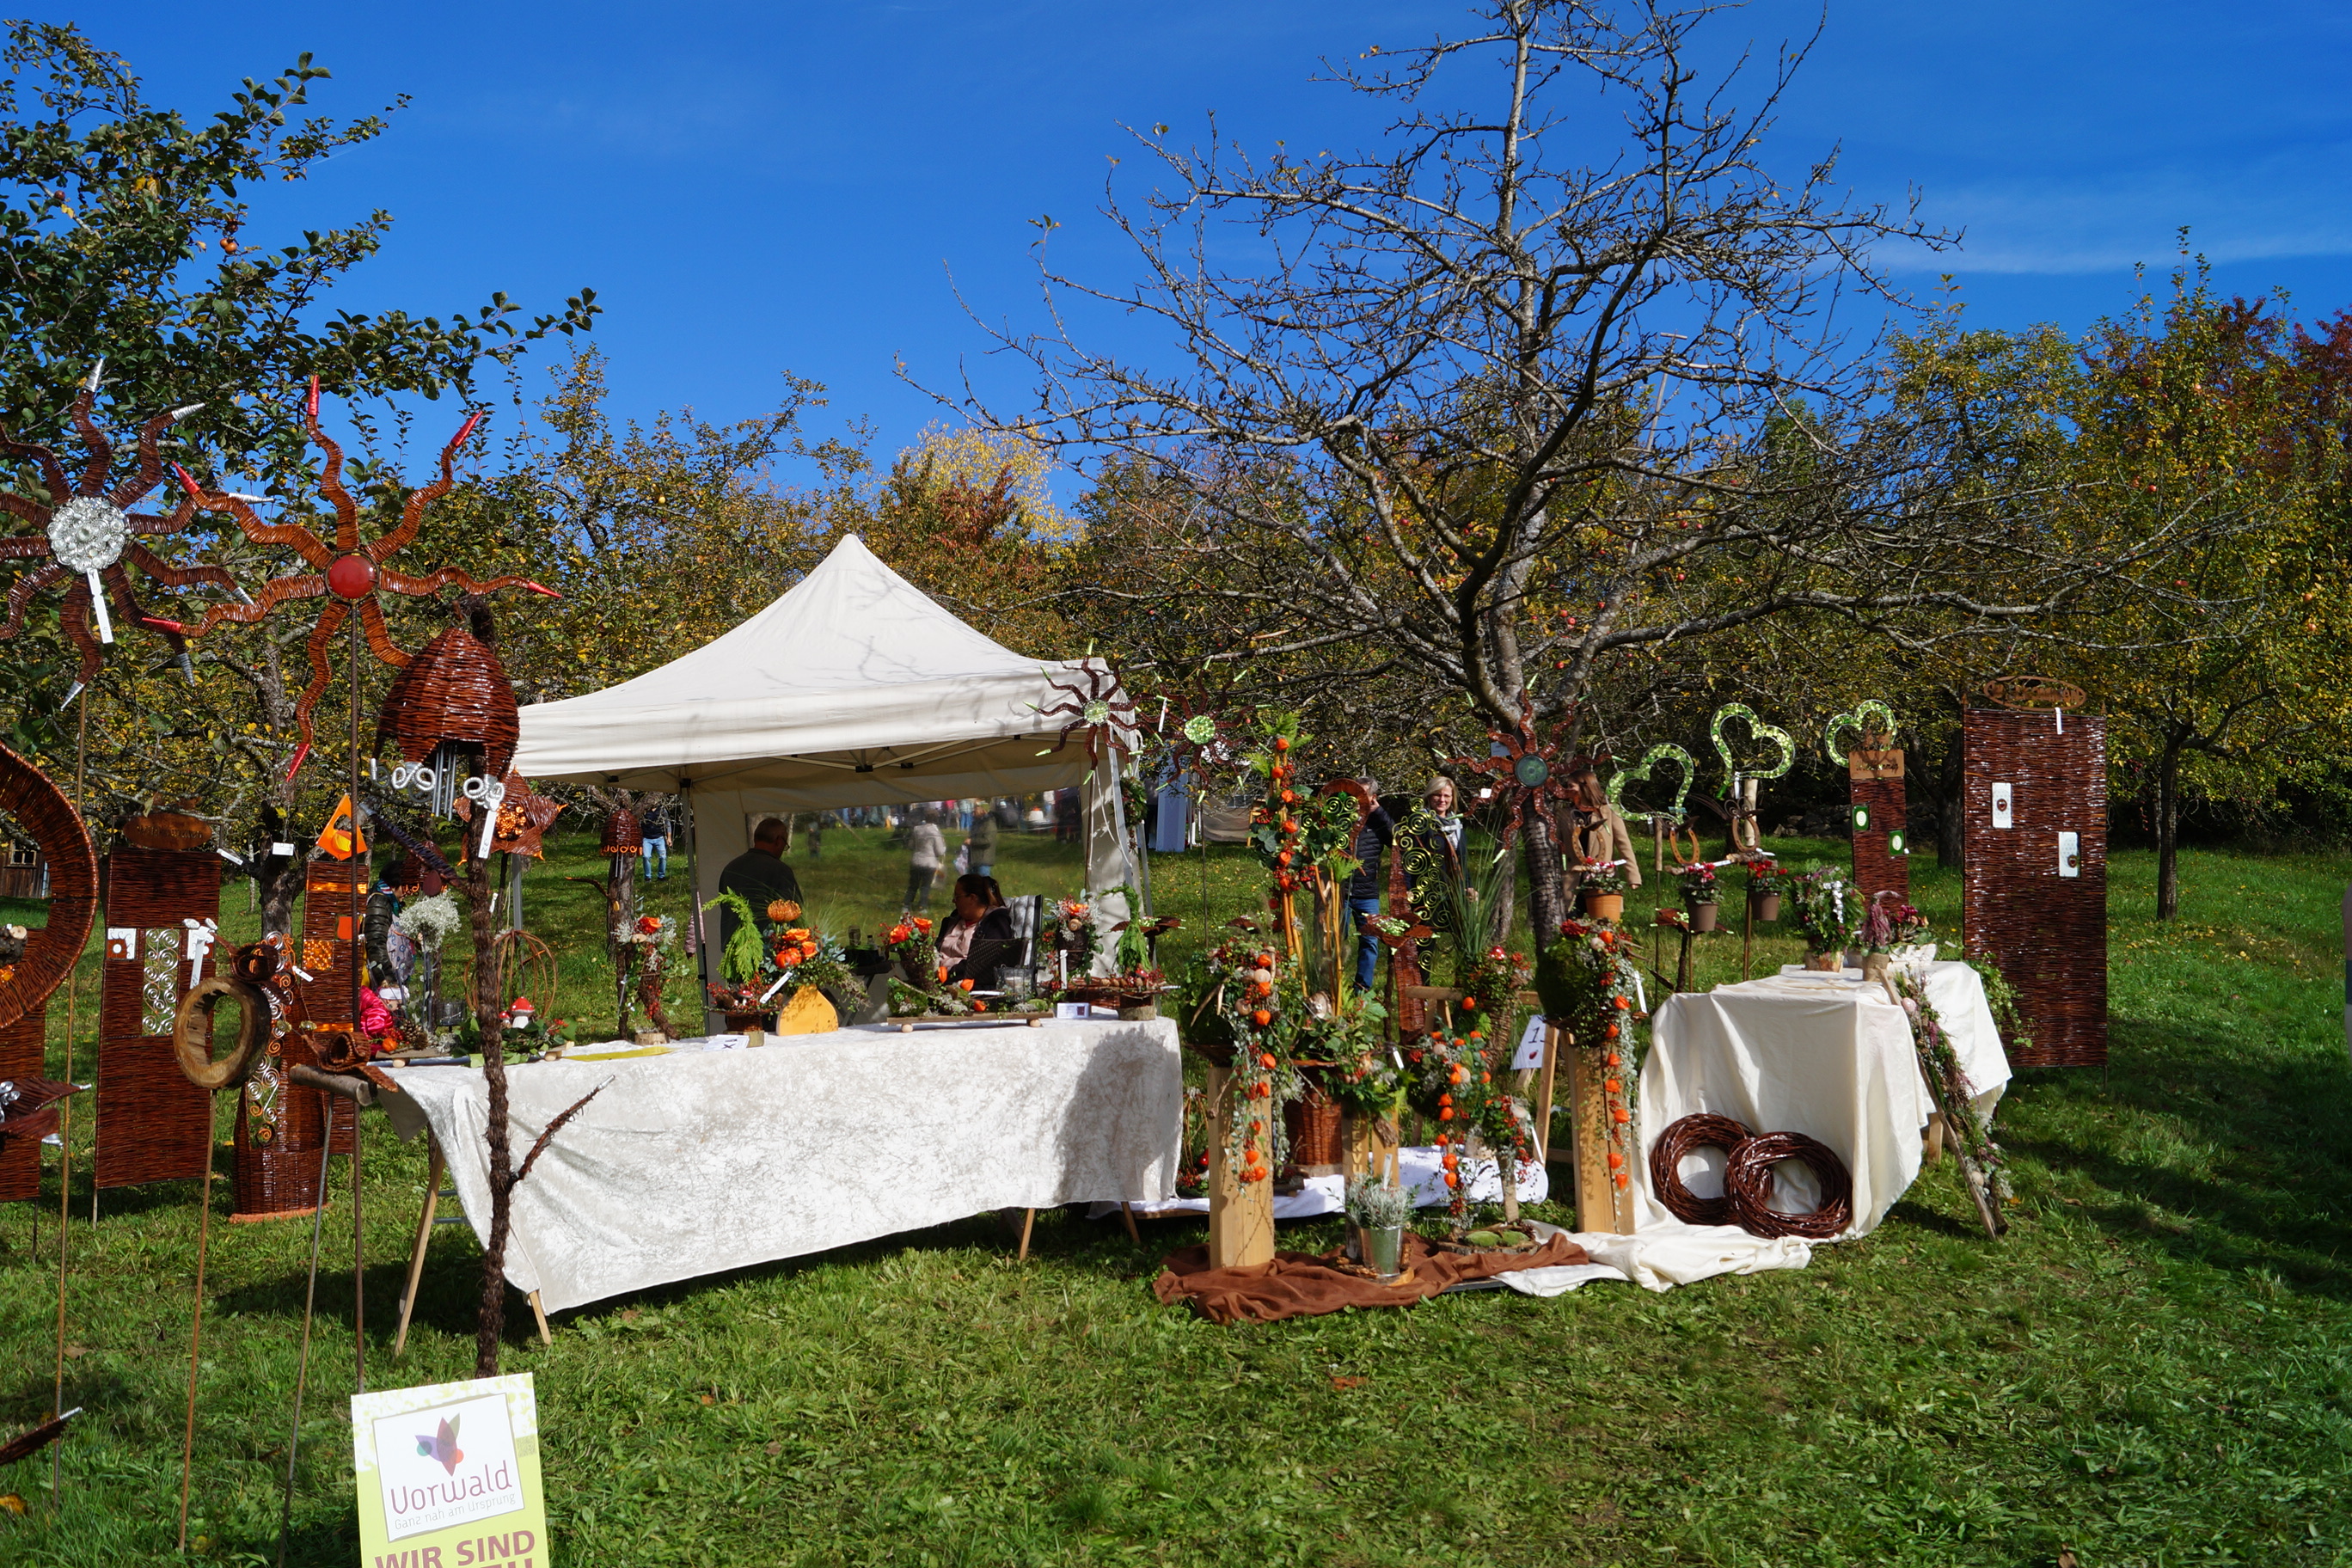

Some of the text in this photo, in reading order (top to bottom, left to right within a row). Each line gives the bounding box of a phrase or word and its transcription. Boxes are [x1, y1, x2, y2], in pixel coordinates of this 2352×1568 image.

[390, 1460, 512, 1515] Vorwald
[395, 1493, 516, 1530] Ganz nah am Ursprung
[375, 1530, 535, 1568] WIR SIND
